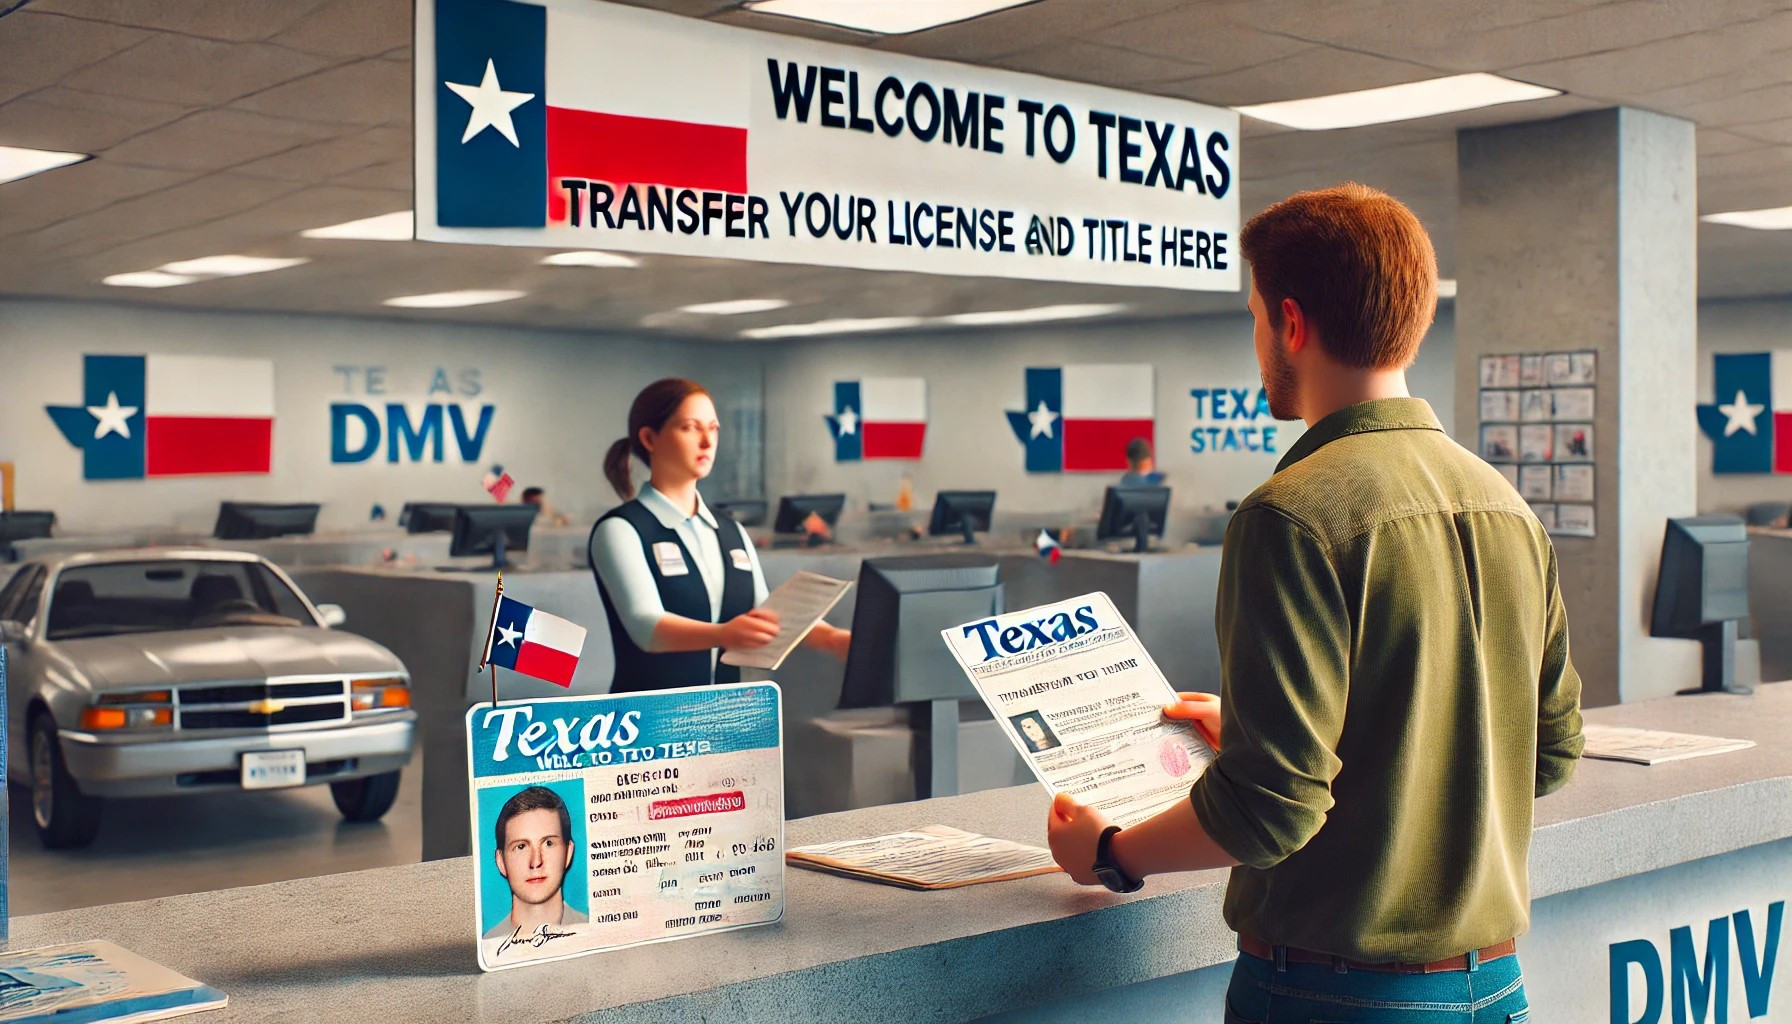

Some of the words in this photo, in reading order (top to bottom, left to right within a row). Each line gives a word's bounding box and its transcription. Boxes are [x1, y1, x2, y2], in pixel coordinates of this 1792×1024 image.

[767, 58, 1005, 155] WELCOME
[1018, 99, 1076, 164] TO
[1089, 110, 1231, 199] TEXAS
[561, 179, 769, 239] TRANSFER
[779, 191, 877, 243] YOUR
[888, 200, 1016, 252] LICENSE
[1025, 214, 1075, 256] AND
[1083, 218, 1152, 264] TITLE
[1161, 226, 1228, 270] HERE
[330, 403, 495, 463] DMV
[963, 605, 1099, 662] Texas
[482, 705, 641, 762] Texas
[1609, 900, 1785, 1024] DMV
